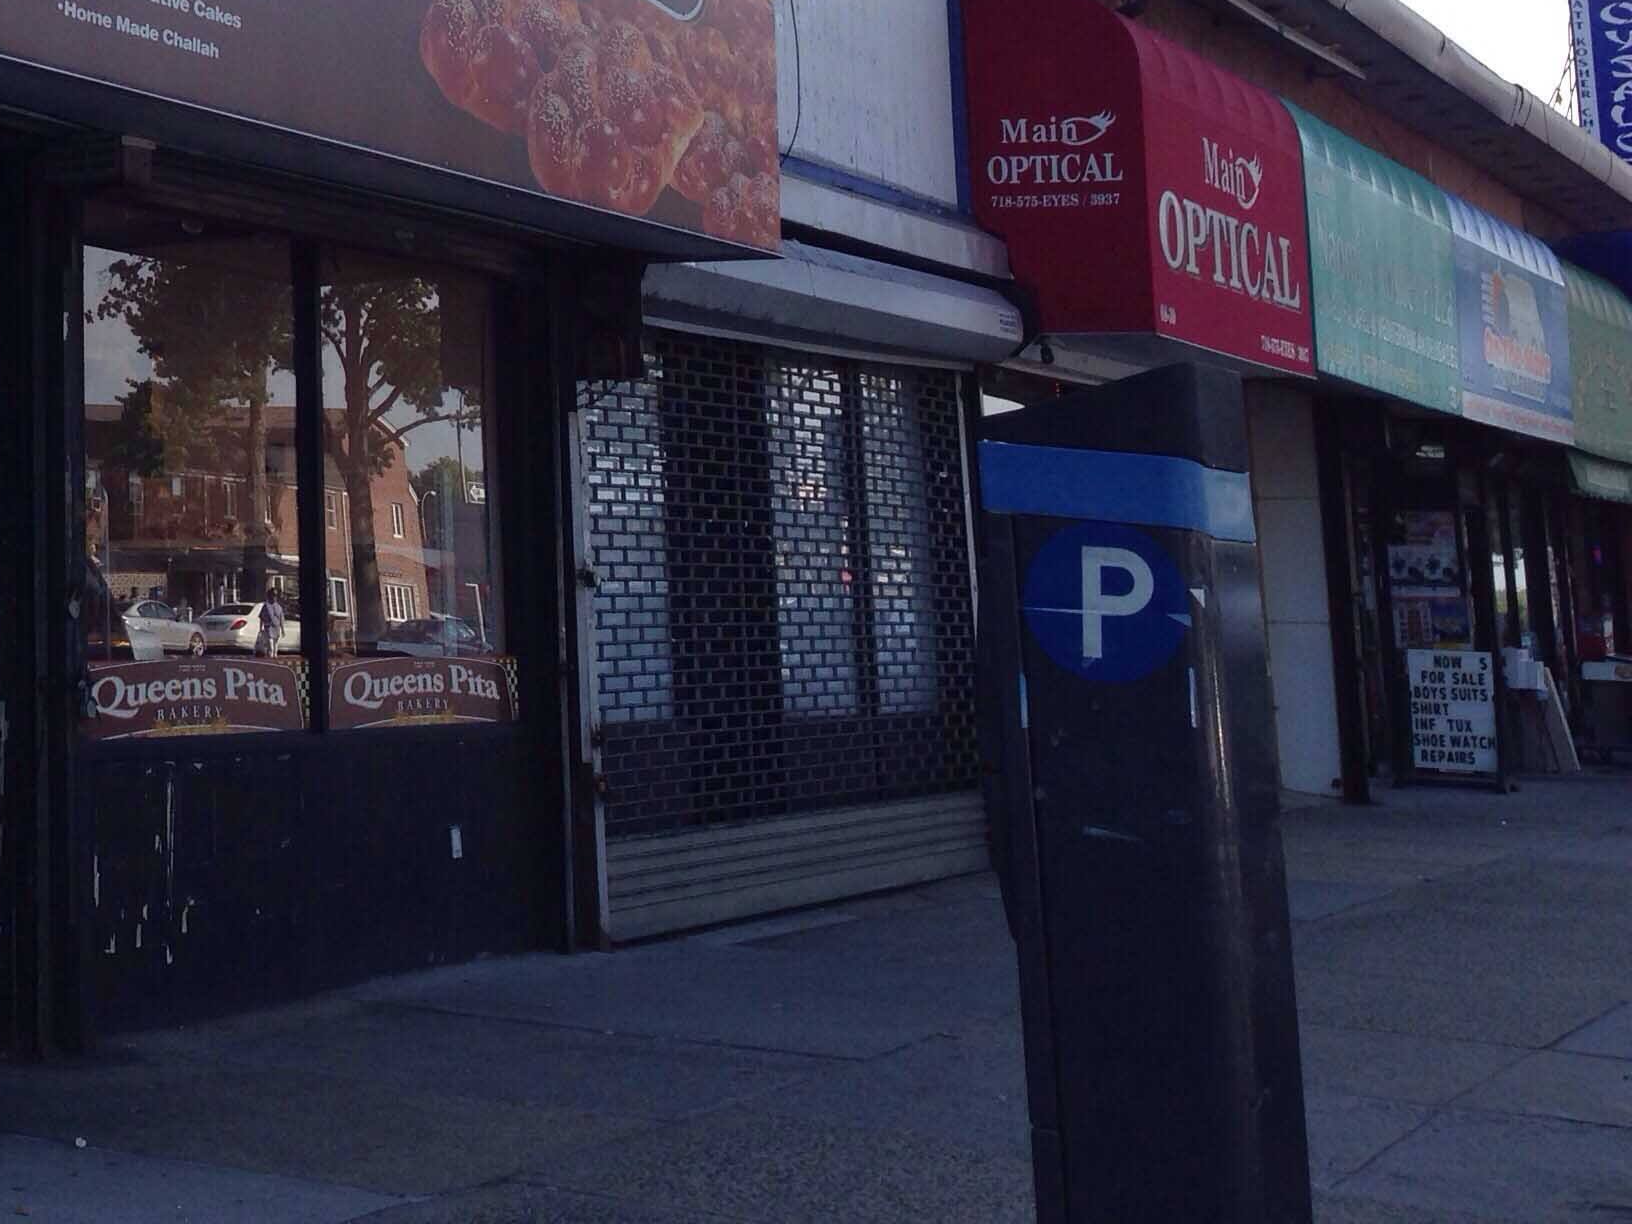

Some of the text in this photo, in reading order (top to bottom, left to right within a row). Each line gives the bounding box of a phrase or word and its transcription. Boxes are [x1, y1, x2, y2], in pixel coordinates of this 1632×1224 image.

[194, 0, 243, 29] Cakes
[116, 15, 159, 42] Made
[162, 28, 220, 60] Challah
[1000, 116, 1079, 144] Main
[987, 153, 1124, 185] OPTICAL
[1203, 137, 1247, 200] Main
[991, 192, 1080, 209] 718-575-EYES
[1159, 190, 1301, 311] OPTICAL
[1081, 545, 1155, 658] P
[1432, 656, 1462, 669] NOW
[1421, 671, 1485, 686] FOR SALE
[90, 669, 287, 719] Queens Pita
[344, 665, 501, 710] Queens Pita
[1414, 686, 1488, 702] BOYS SUITS
[156, 705, 224, 721] BAKERY
[397, 697, 451, 713] BAKERY
[1412, 703, 1449, 716] SHIRT
[1447, 719, 1473, 732] TUX
[1414, 734, 1496, 749] SHOE WATCH
[1421, 750, 1476, 764] REPAIRS
